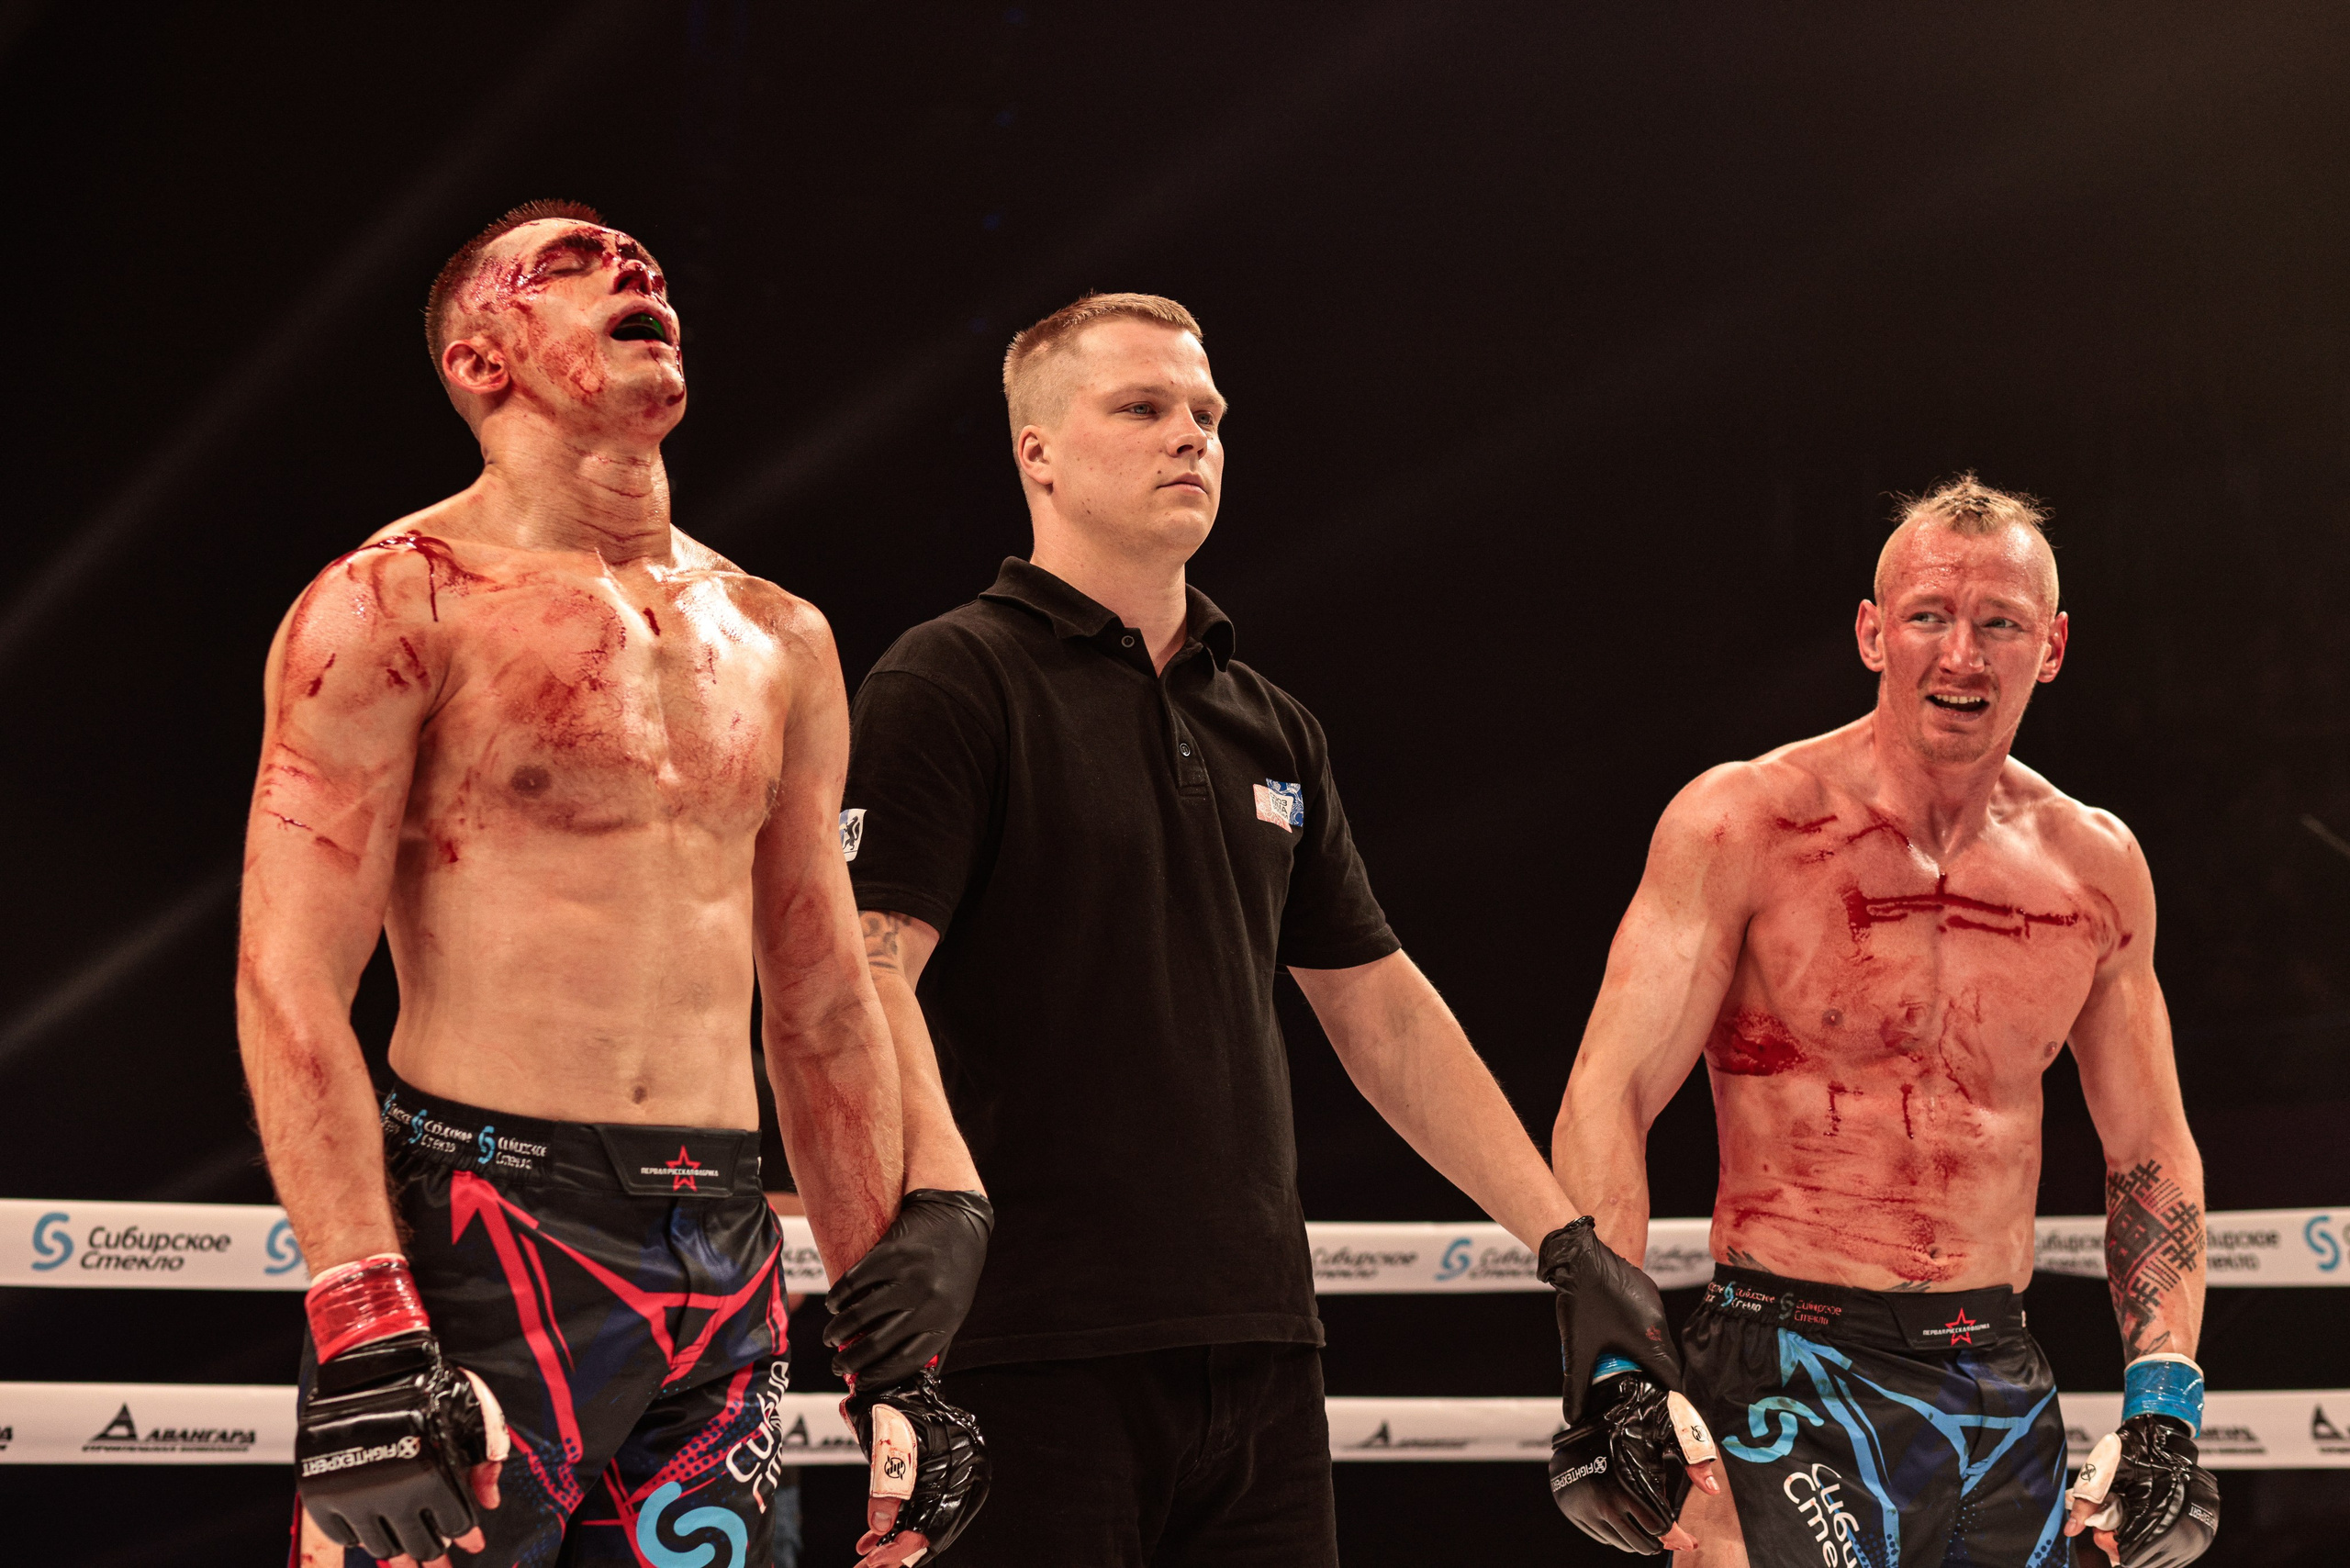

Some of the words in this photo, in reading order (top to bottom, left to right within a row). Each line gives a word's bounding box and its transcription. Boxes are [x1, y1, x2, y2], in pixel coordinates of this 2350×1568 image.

[88, 1226, 231, 1253] Сибирское
[80, 1250, 185, 1271] Стекло
[301, 1442, 398, 1477] FIGHTEXPERT
